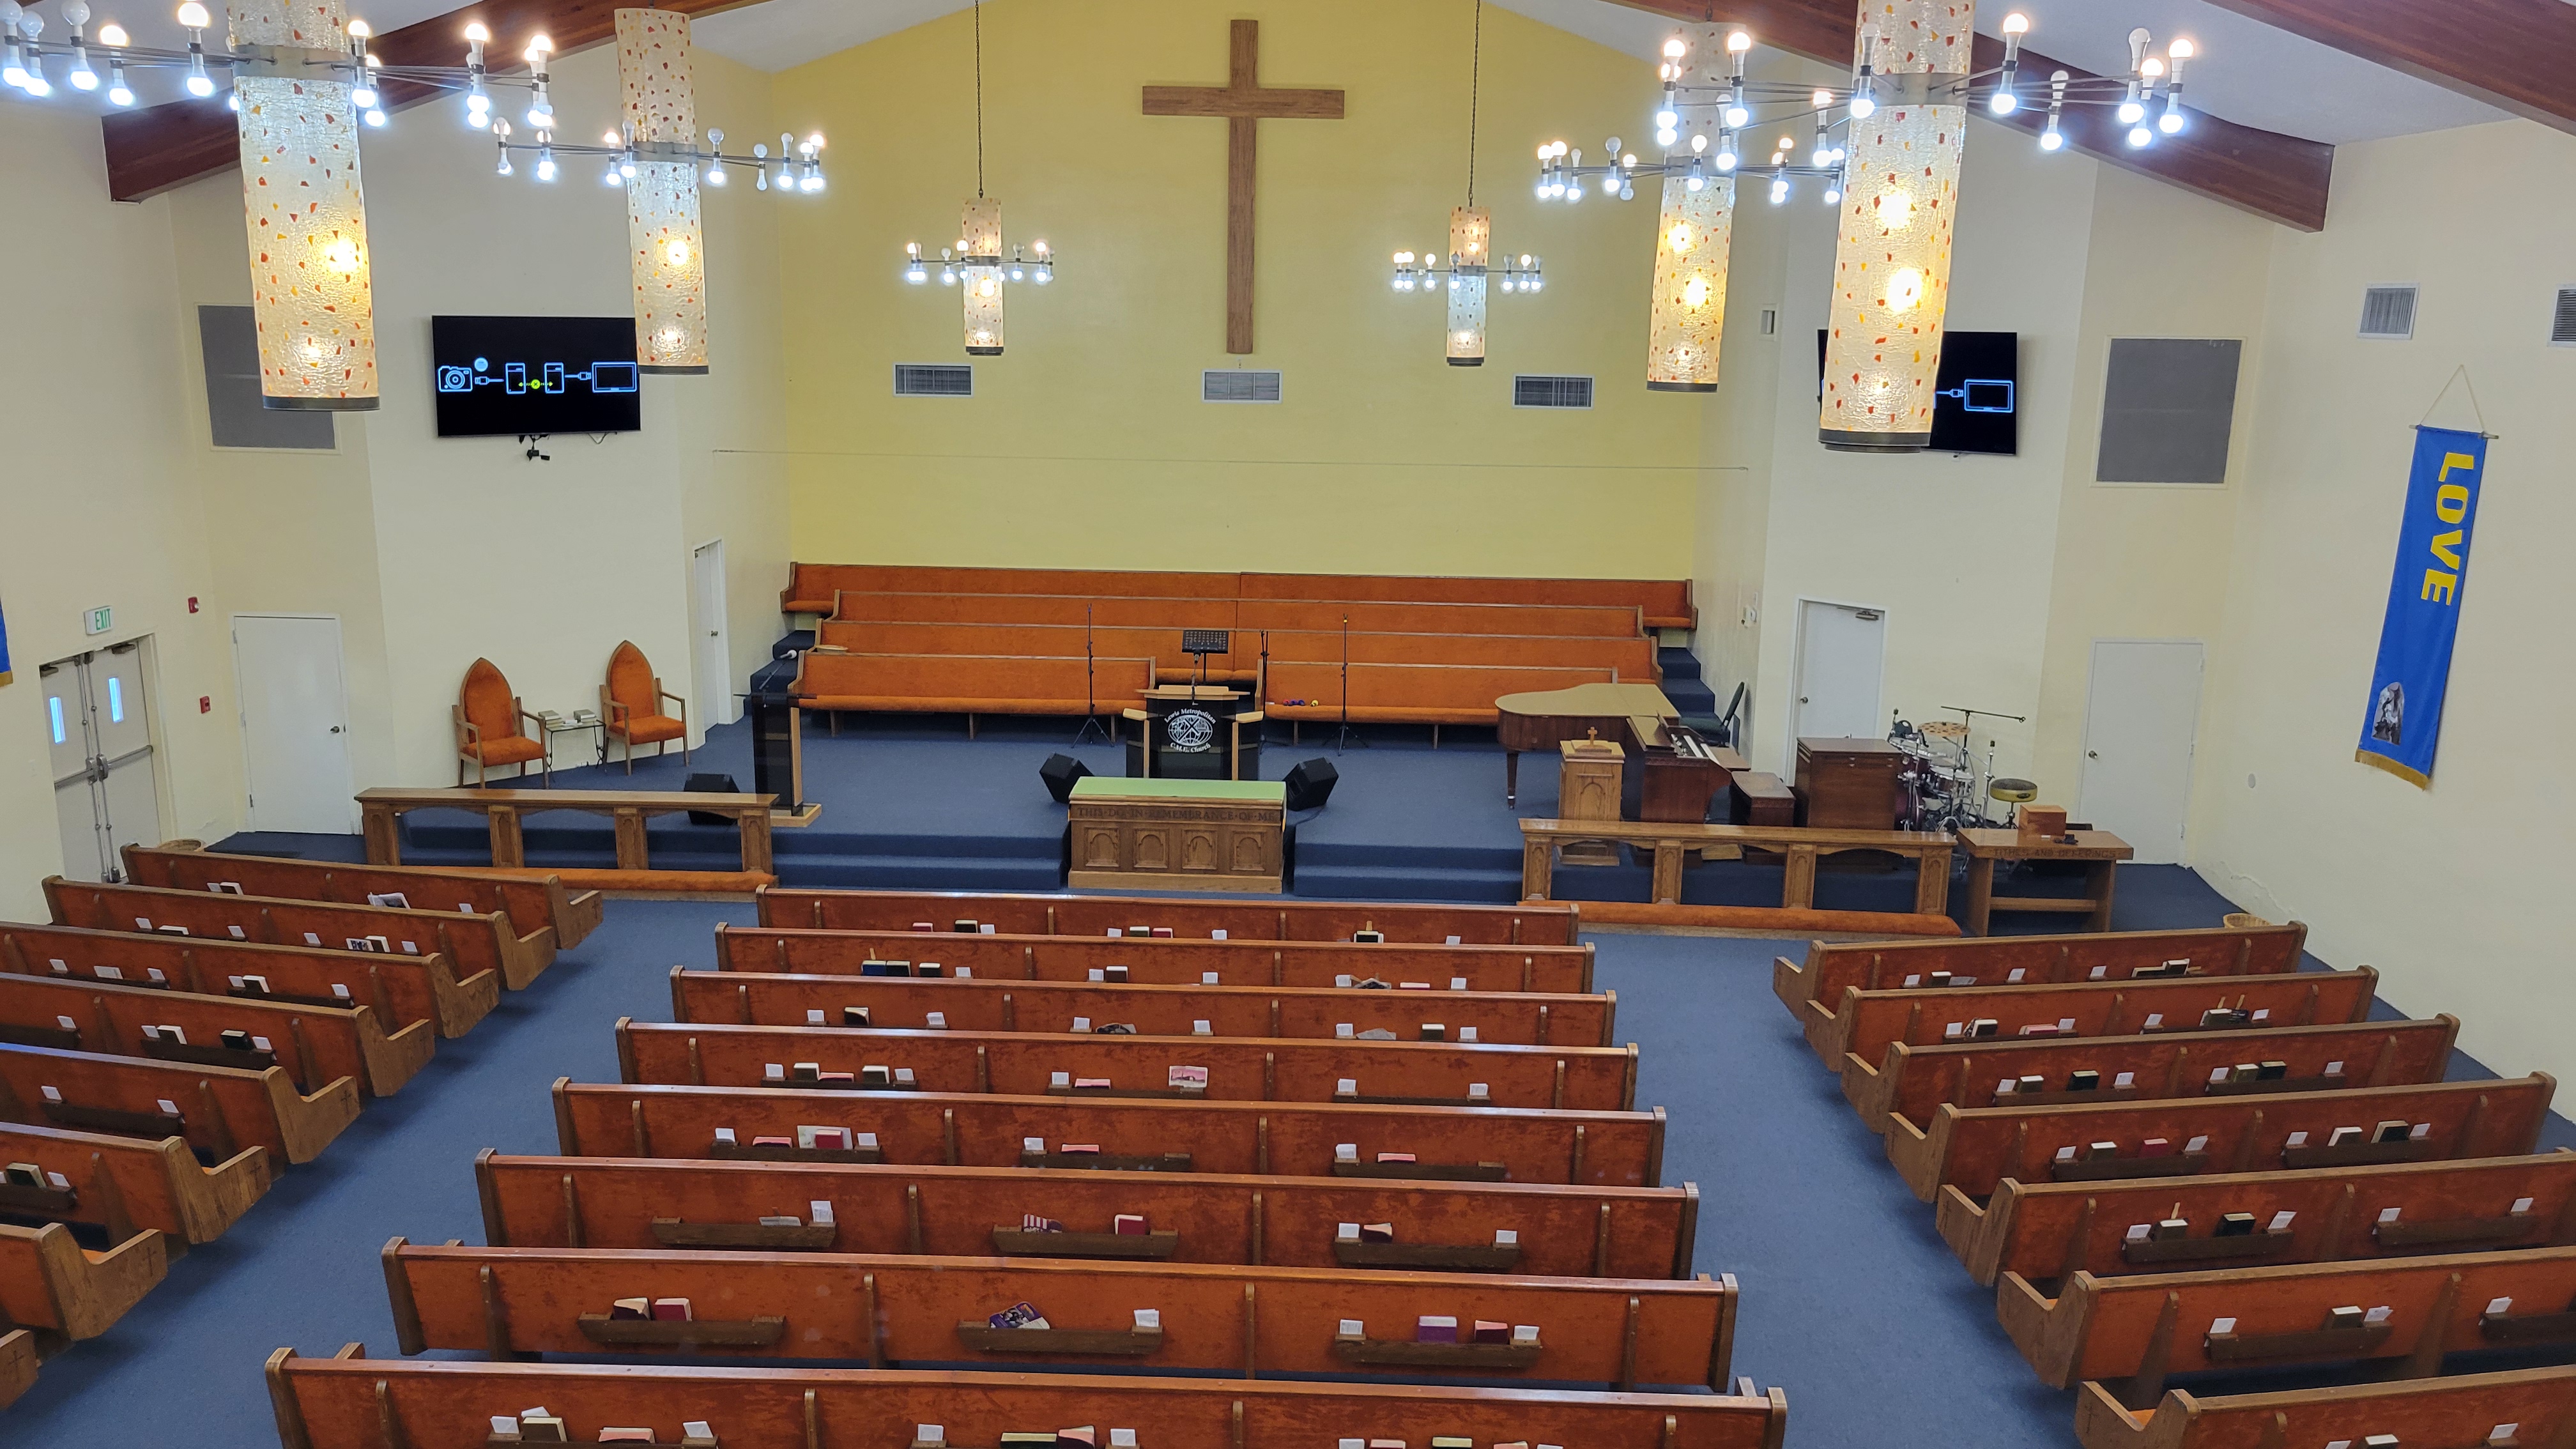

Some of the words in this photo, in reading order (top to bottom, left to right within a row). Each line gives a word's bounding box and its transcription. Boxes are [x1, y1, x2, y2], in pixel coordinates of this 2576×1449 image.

[2421, 452, 2474, 606] LOVE
[95, 608, 111, 631] EXIT
[1164, 710, 1180, 723] Lewis
[1181, 708, 1216, 724] Metropolitan
[1170, 742, 1190, 753] C.M.E.
[1190, 742, 1211, 753] Church
[1077, 808, 1103, 816] THIS
[1131, 808, 1144, 818] IN
[2034, 848, 2054, 857] AND
